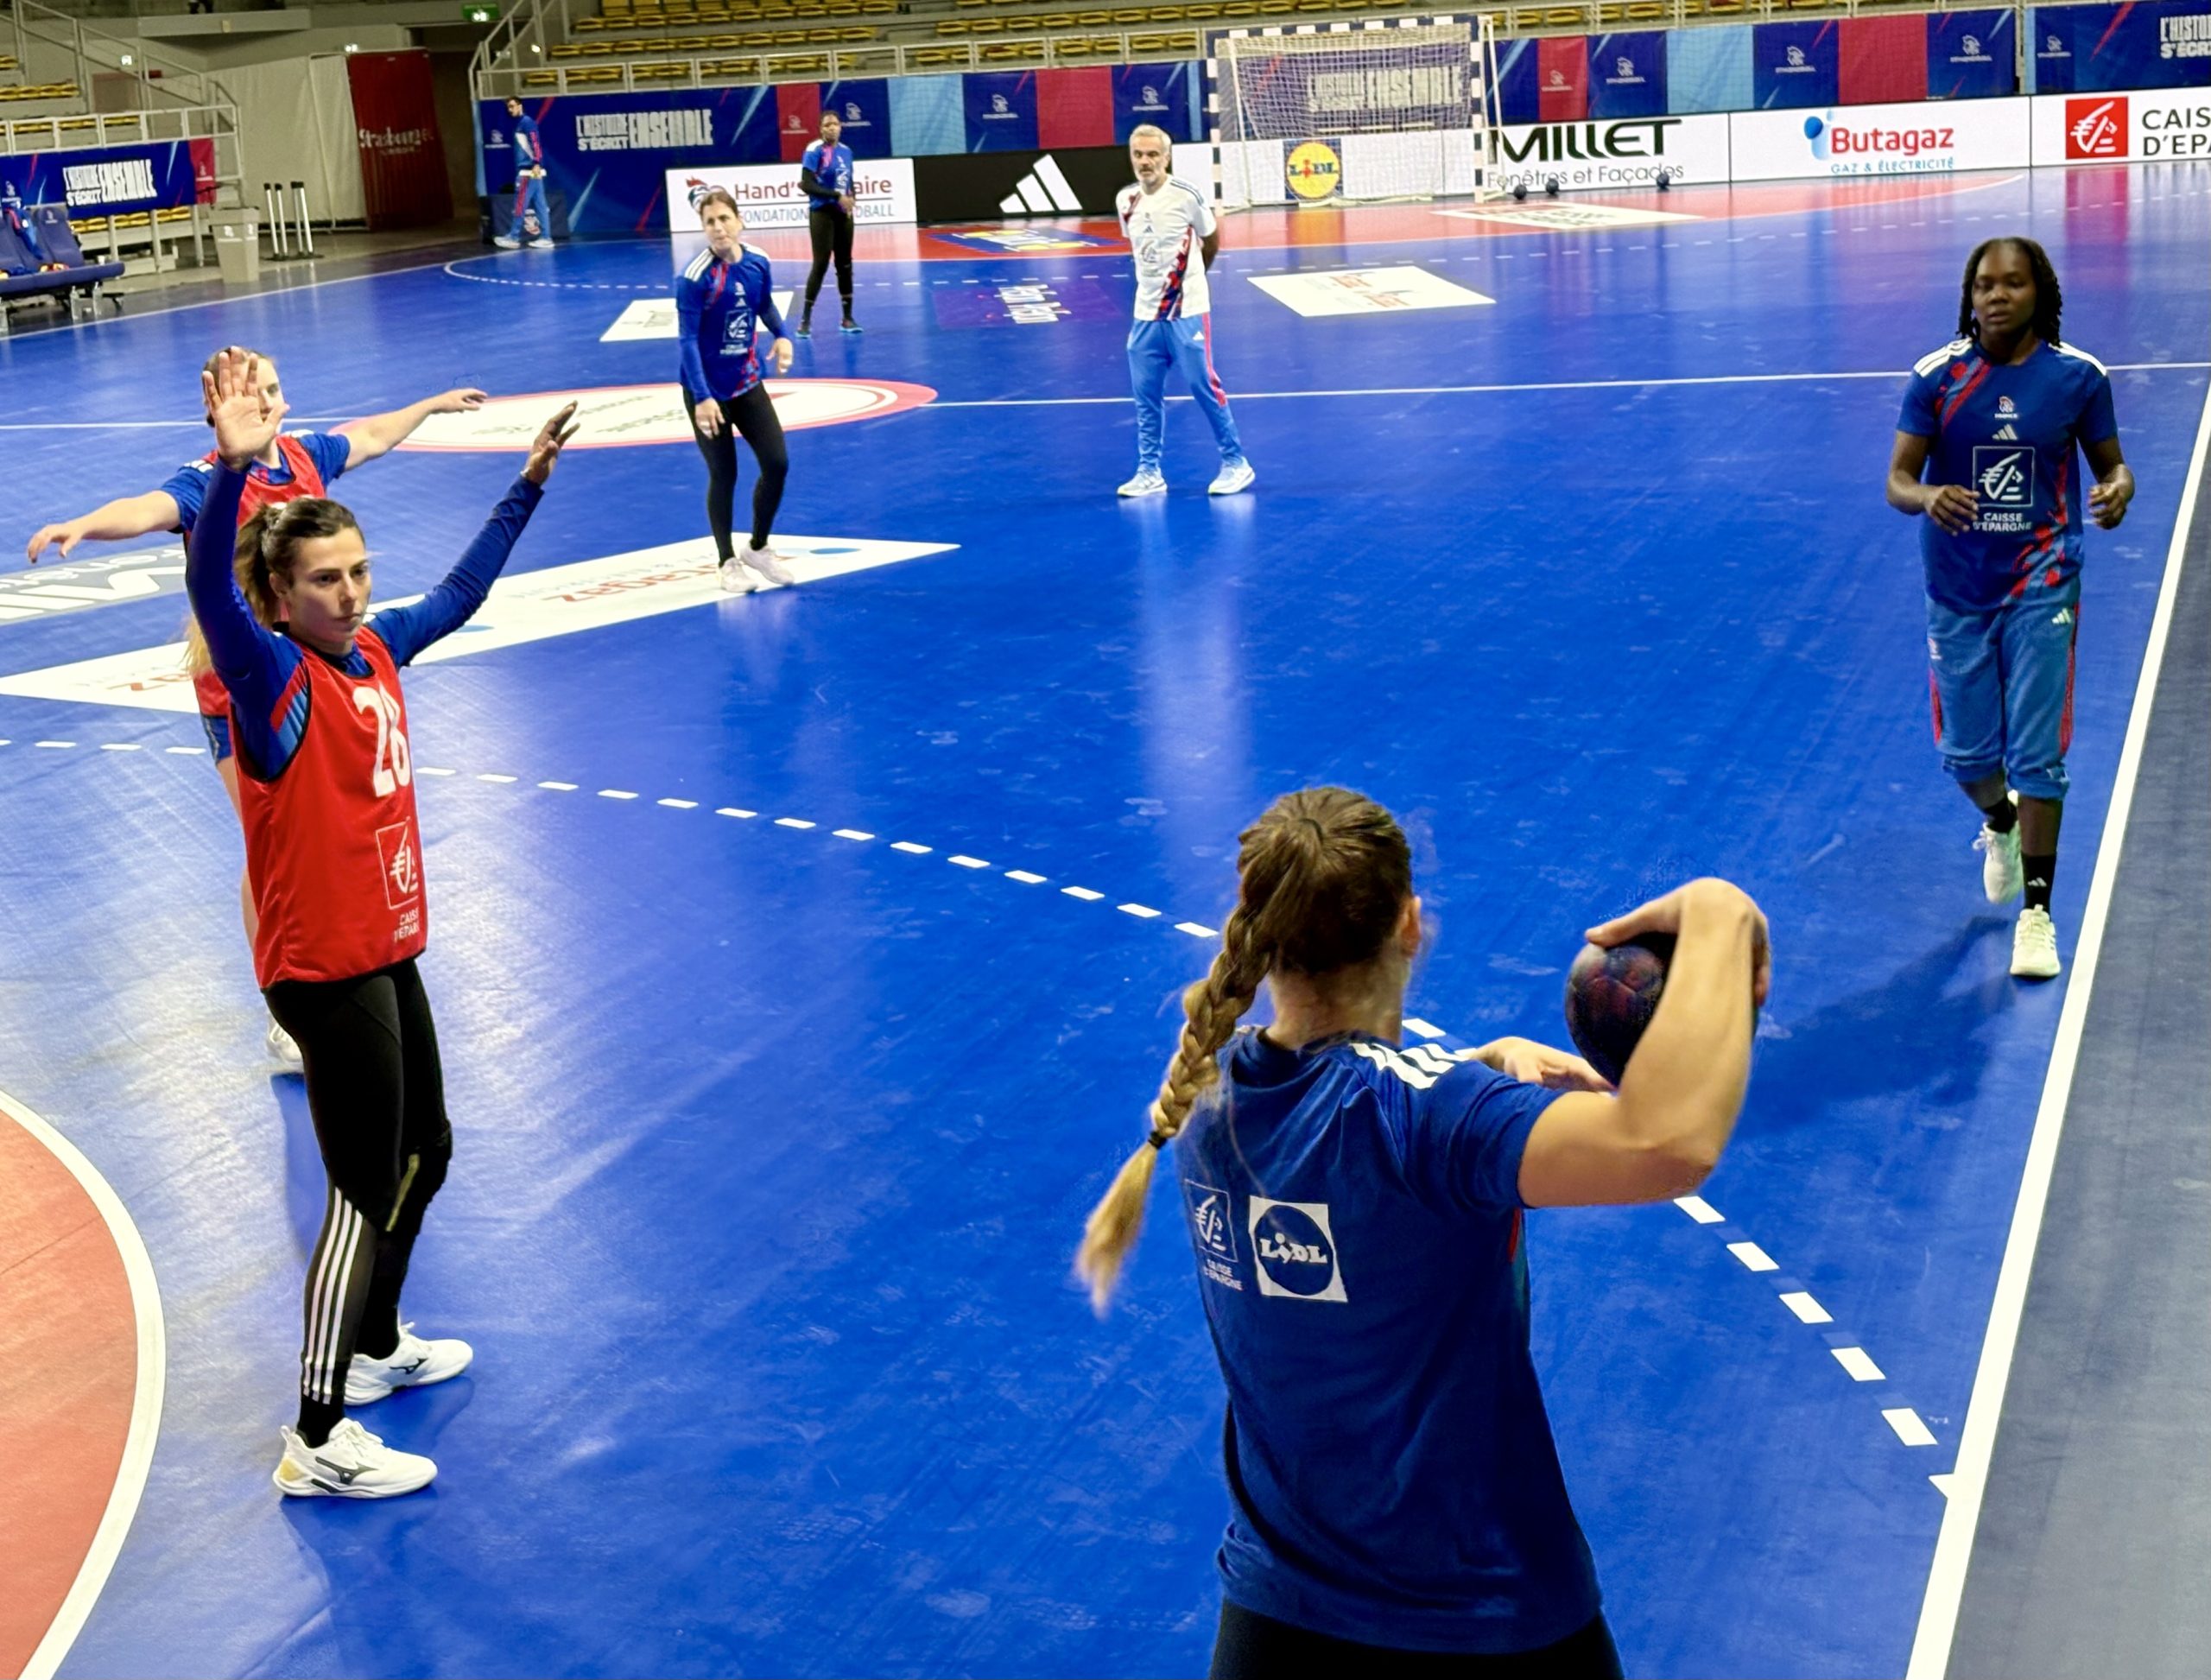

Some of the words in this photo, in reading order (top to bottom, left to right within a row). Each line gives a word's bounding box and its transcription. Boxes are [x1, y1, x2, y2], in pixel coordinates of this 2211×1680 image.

[628, 109, 714, 149] ENSEMBLE
[1491, 118, 1682, 164] MILLET
[1831, 127, 1954, 156] Butagaz
[1573, 167, 1593, 183] et
[1830, 162, 1858, 174] GAZ
[1864, 162, 1872, 172] &
[1878, 156, 1954, 172] ÉLECTRICITÉ
[1983, 512, 2023, 522] CAISSE
